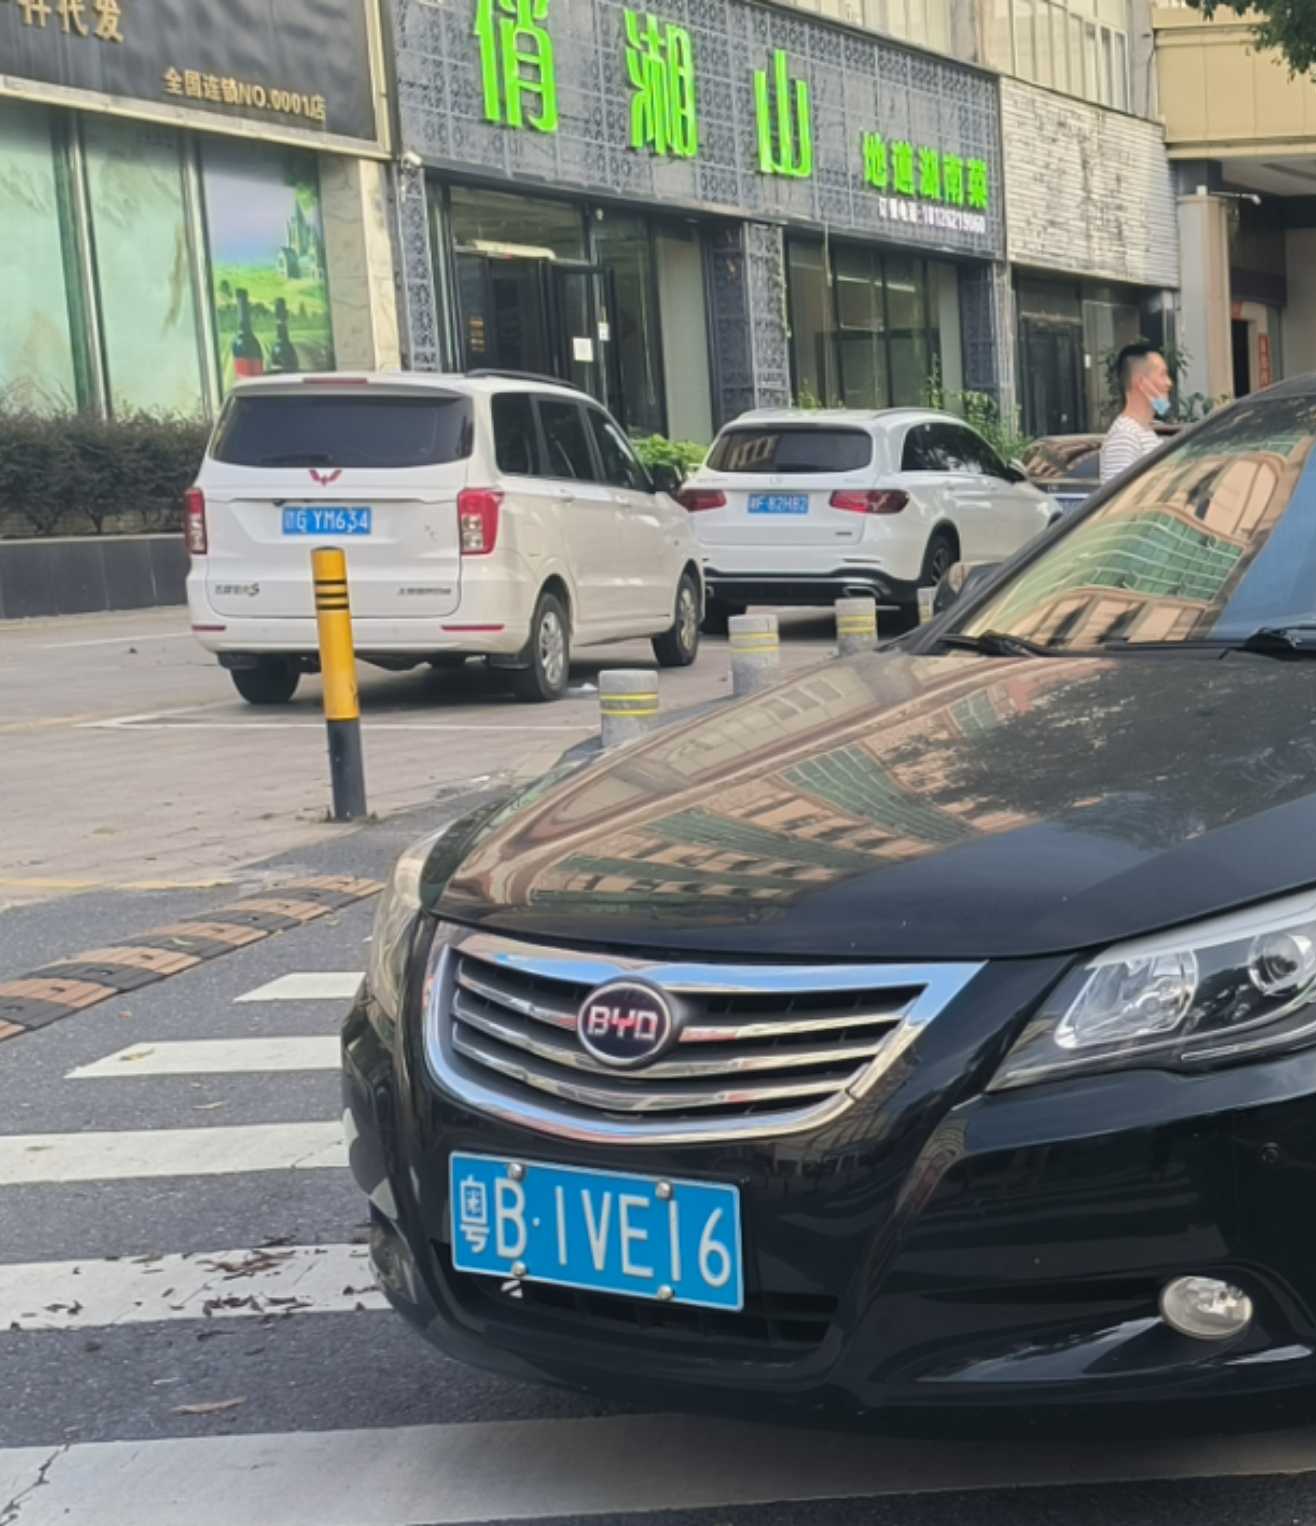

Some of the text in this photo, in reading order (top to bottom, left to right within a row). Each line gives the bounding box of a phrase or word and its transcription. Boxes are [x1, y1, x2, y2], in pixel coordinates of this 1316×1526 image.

[863, 131, 987, 209] 地道湖南菜
[587, 1006, 658, 1040] BYD
